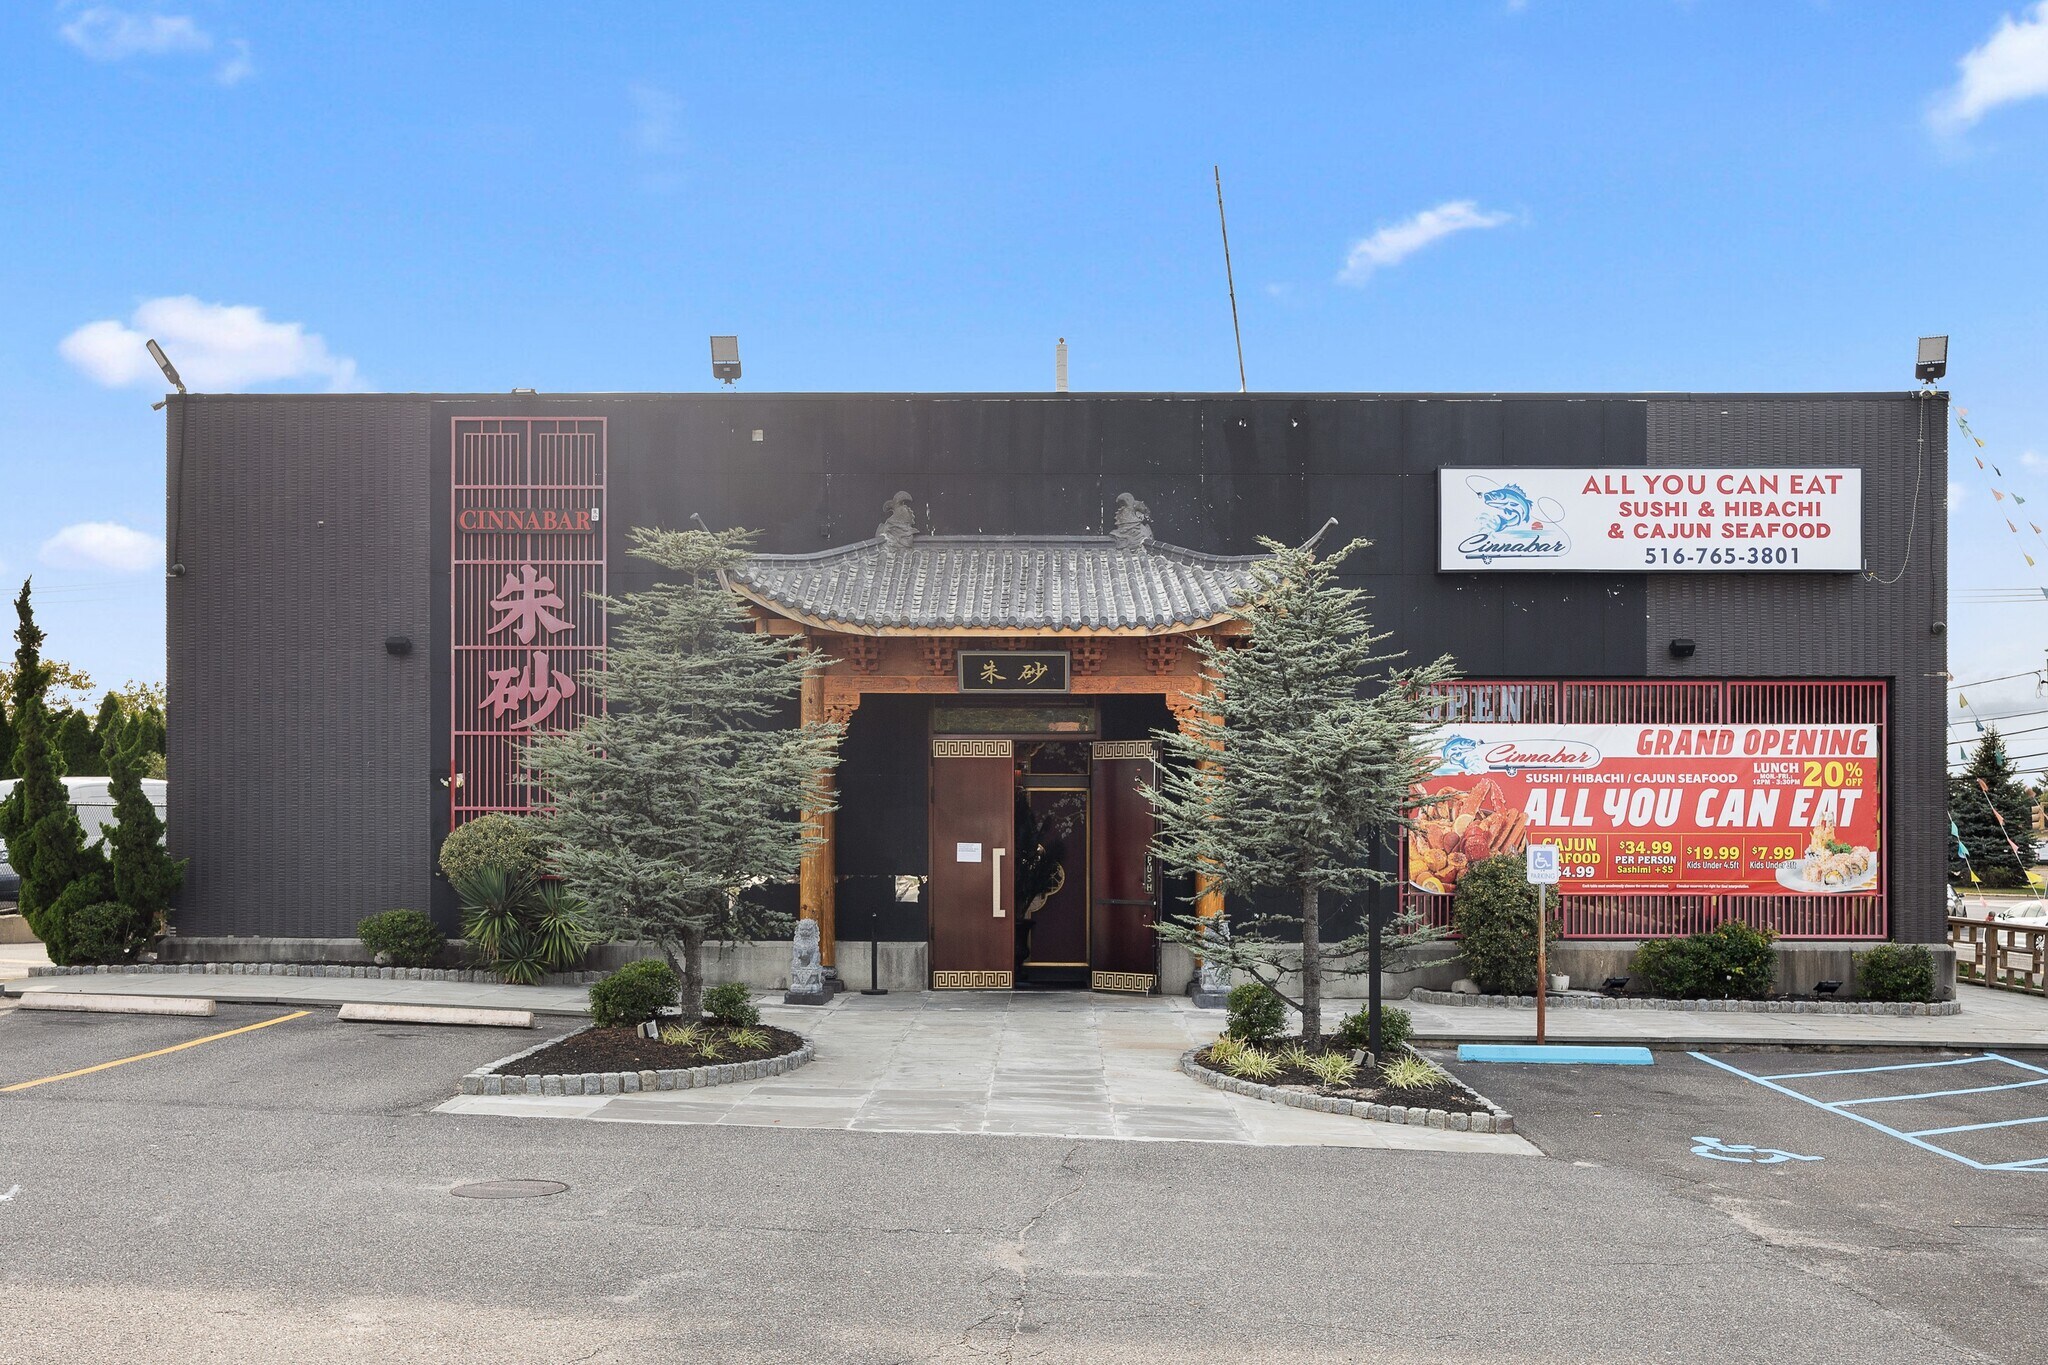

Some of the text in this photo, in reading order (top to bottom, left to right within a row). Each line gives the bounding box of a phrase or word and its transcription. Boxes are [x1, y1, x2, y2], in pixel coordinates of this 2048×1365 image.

[1581, 474, 1844, 496] ALL YOU CAN EAT
[1618, 501, 1821, 518] SUSHI & HIBACHI
[458, 509, 592, 532] CINNABAR
[1607, 523, 1832, 539] & CAJUN SEAFOOD
[1457, 533, 1567, 553] Cinnabar
[1644, 547, 1799, 565] 516-765-3801
[478, 564, 576, 731] 朱砂
[980, 659, 1048, 685] 朱砂
[1635, 728, 1868, 756] GRAND OPENING
[1484, 742, 1592, 764] Cinnabar
[1753, 762, 1800, 774] LUNCH
[1525, 773, 1563, 784] SUSHI
[1572, 773, 1625, 784] HIBACHI
[1633, 773, 1676, 784] CAJUN
[1678, 773, 1738, 784] SEAFOOD
[1845, 778, 1863, 787] OFF
[1525, 788, 1863, 828] ALL YOU CAN EAT
[1619, 840, 1673, 855] $34.99
[1686, 846, 1740, 860] $19.99
[1751, 846, 1795, 860] $7.99
[1558, 852, 1601, 864] AFOOD
[1615, 855, 1677, 865] PER PERSON
[1686, 861, 1701, 869] Kids
[1702, 861, 1722, 869] Under
[1749, 861, 1764, 869] Kids
[1765, 861, 1786, 869] Under
[1530, 872, 1556, 880] PARKING
[1617, 865, 1651, 874] Sashimi
